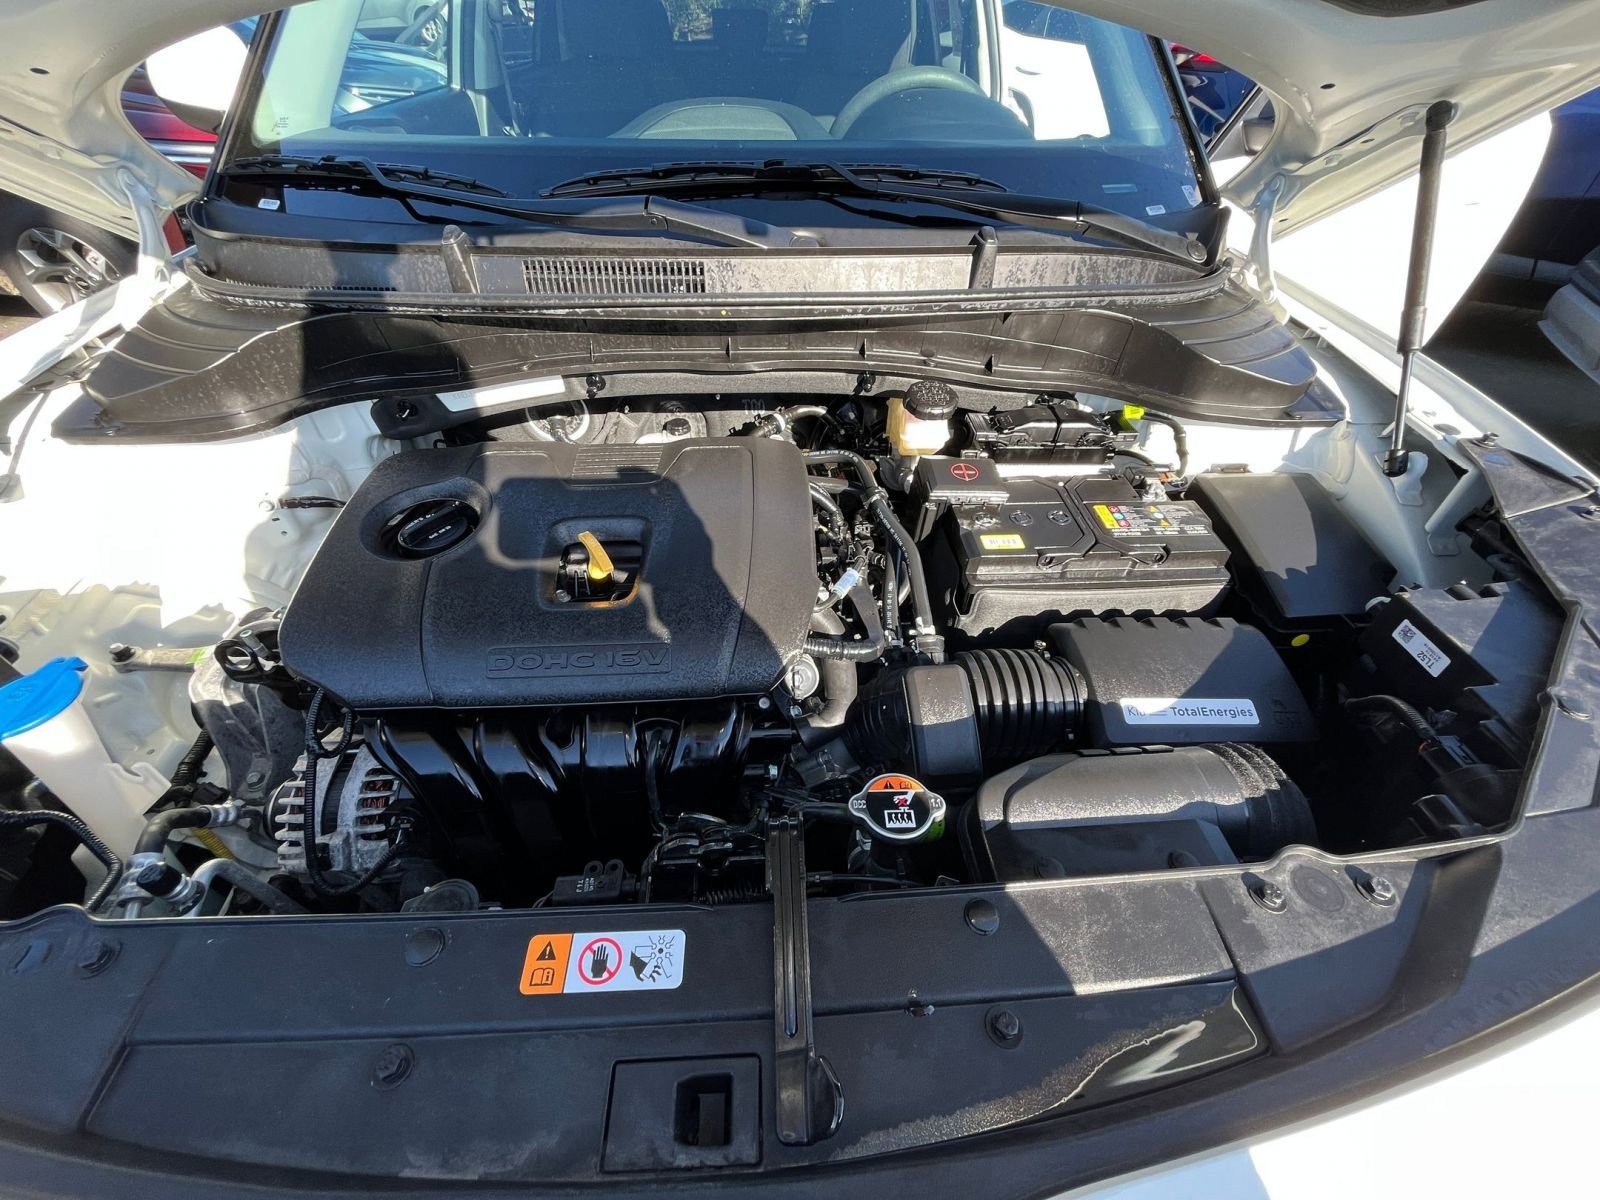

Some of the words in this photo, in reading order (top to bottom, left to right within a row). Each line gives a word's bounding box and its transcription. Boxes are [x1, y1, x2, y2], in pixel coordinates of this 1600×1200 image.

[488, 652, 595, 672] DOHC
[607, 649, 668, 668] 16V
[1169, 706, 1254, 719] TotalEnergies
[930, 798, 941, 808] 1.1
